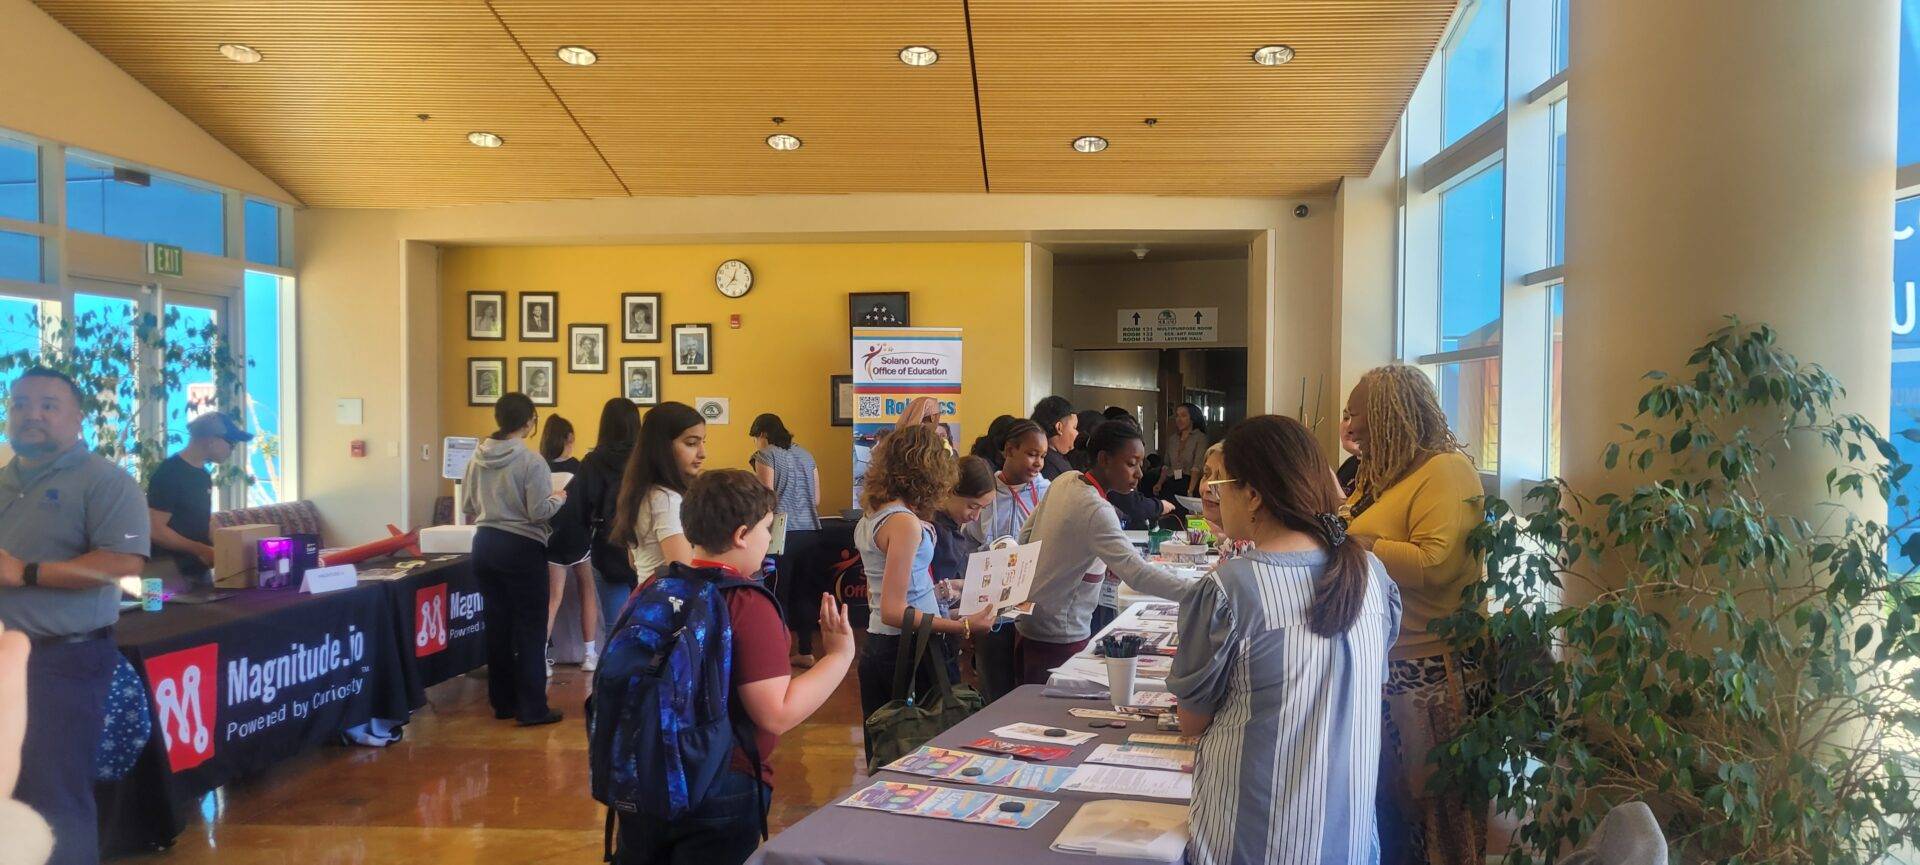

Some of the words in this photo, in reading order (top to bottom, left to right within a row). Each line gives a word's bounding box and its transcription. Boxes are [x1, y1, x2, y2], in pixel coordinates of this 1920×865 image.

[157, 246, 180, 274] EXIT
[873, 366, 897, 375] Office
[898, 366, 907, 375] of
[908, 366, 948, 375] Education
[881, 356, 910, 365] Solano
[911, 356, 940, 367] County
[227, 624, 364, 707] Magnitude.io
[292, 700, 310, 719] by
